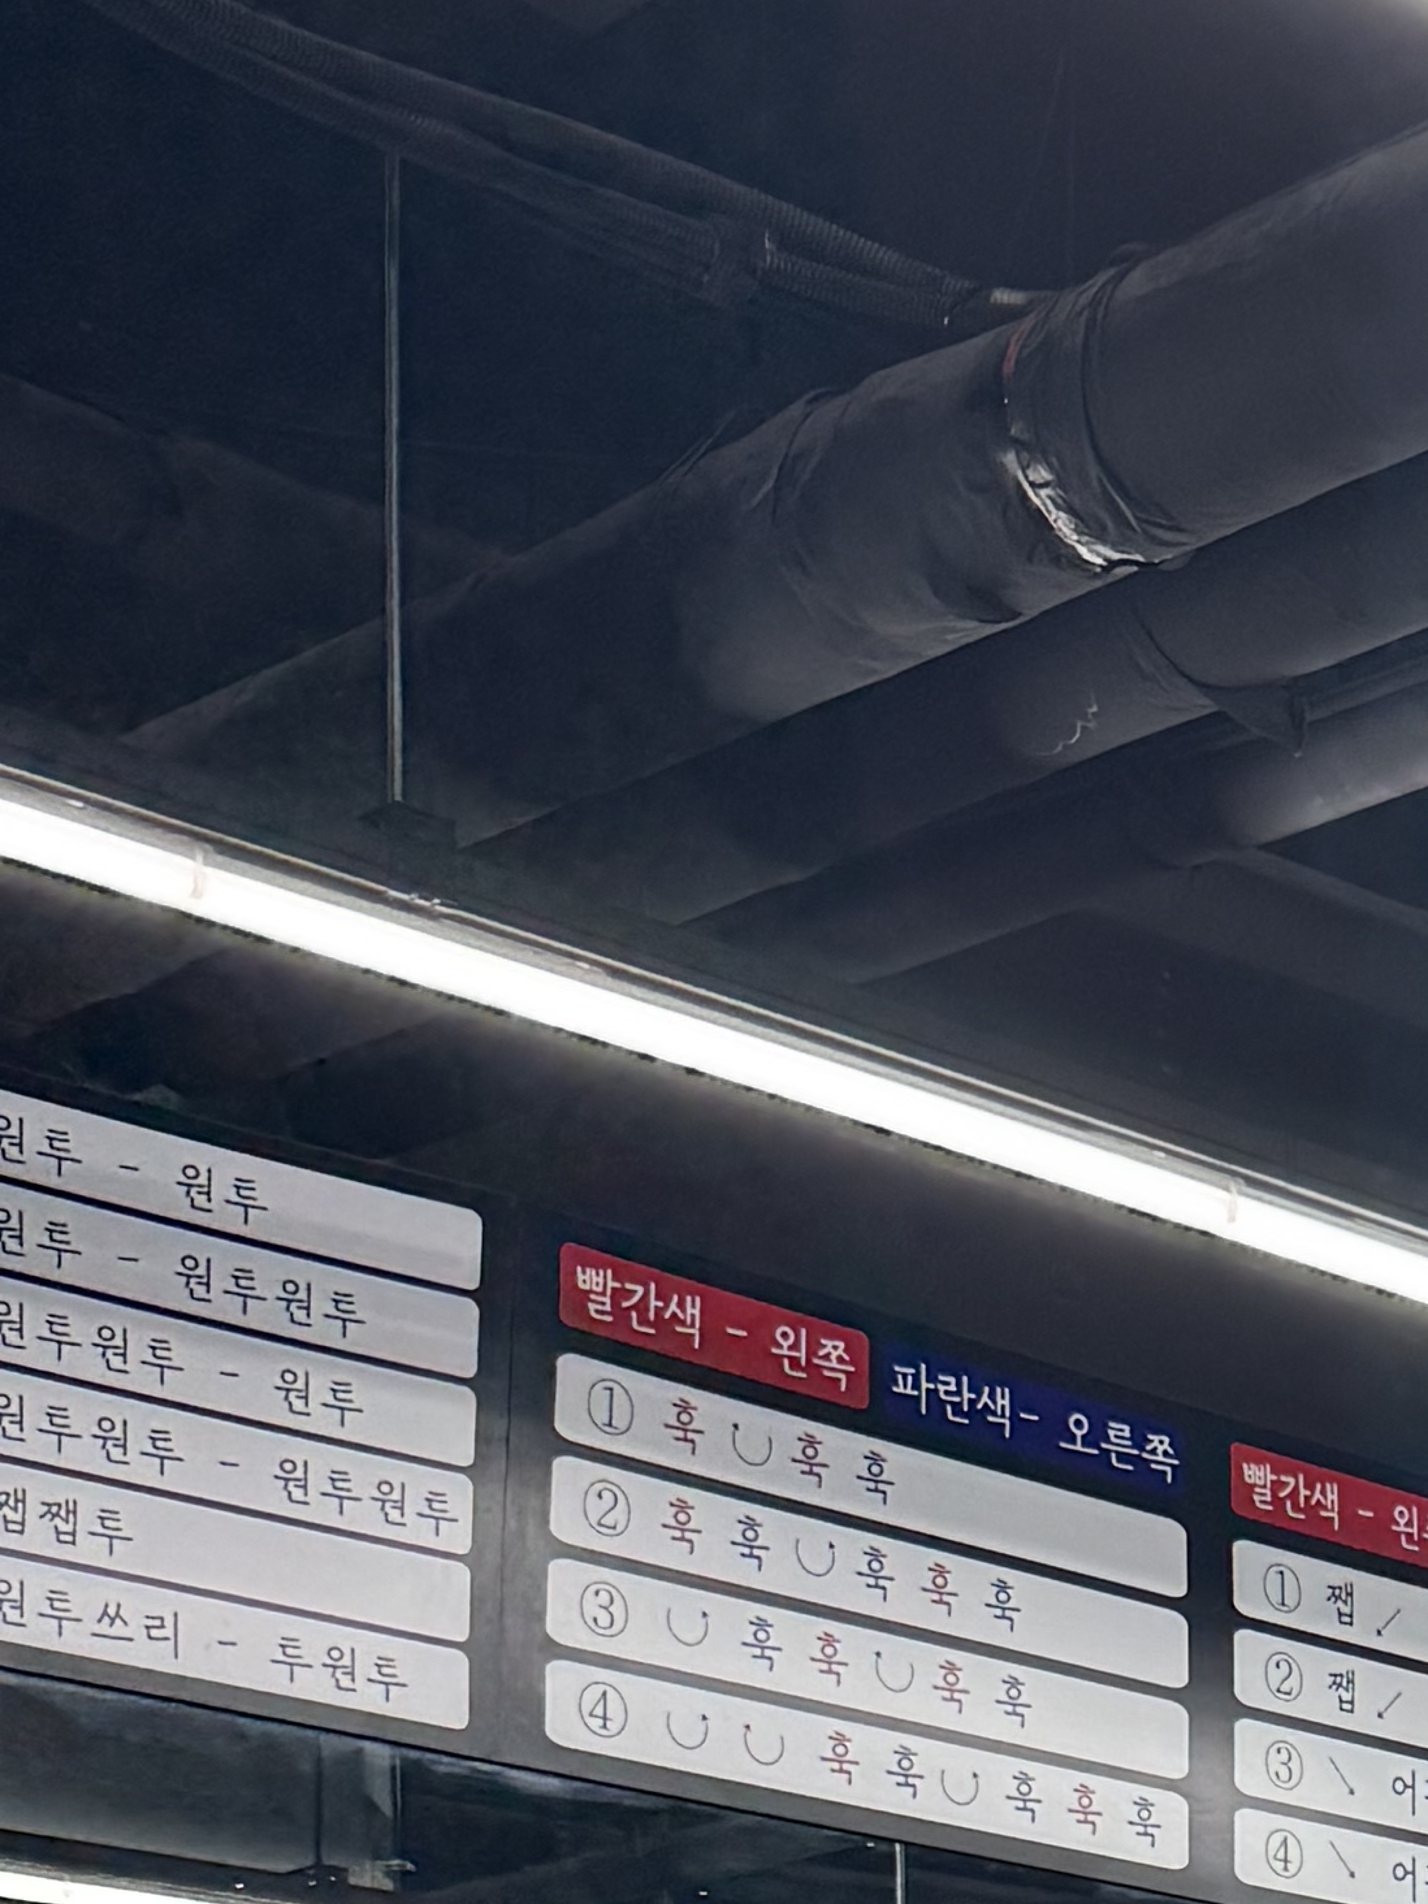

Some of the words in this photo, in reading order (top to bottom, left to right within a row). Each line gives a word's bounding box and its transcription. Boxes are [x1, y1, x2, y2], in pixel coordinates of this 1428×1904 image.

[175, 1163, 269, 1227] 원투
[173, 1253, 367, 1339] 원투원투
[575, 1264, 701, 1350] 빨간색
[770, 1324, 856, 1393] 왼쪽
[273, 1367, 365, 1429] 원투
[662, 1397, 705, 1457] 훅
[790, 1431, 831, 1489] 훅
[855, 1449, 896, 1506] 훅
[1058, 1411, 1181, 1485] 오른쪽
[272, 1457, 460, 1538] 원투원투
[1241, 1462, 1340, 1532] 빨간색
[660, 1497, 703, 1556] 훅
[729, 1514, 771, 1573] 훅
[854, 1544, 896, 1603] 훅
[920, 1561, 960, 1618] 훅
[983, 1577, 1022, 1633] 훅
[269, 1636, 409, 1703] 투원투
[740, 1615, 784, 1673] 훅
[809, 1630, 849, 1687] 훅
[932, 1659, 971, 1715] 훅
[994, 1674, 1033, 1729] 훅
[819, 1730, 861, 1786] 훅
[885, 1744, 925, 1800] 훅
[1004, 1770, 1043, 1824] 훅
[1067, 1782, 1104, 1836] 훅
[1126, 1795, 1163, 1849] 훅
